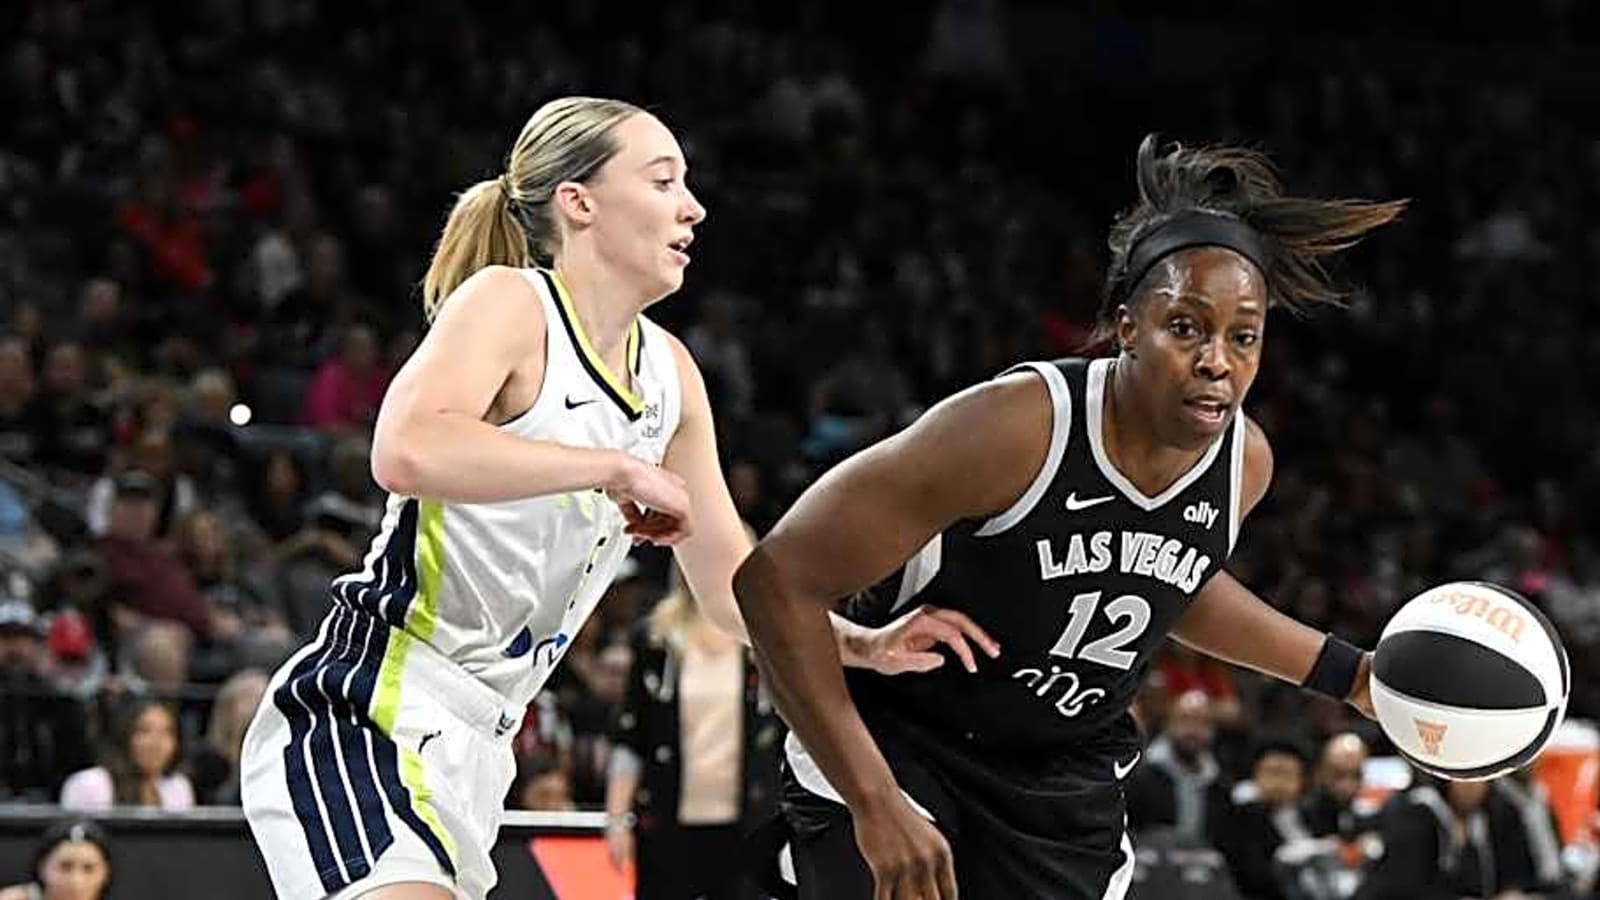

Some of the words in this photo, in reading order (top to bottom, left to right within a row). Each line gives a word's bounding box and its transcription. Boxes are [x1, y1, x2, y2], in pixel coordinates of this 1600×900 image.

[1183, 501, 1219, 530] ally
[1036, 531, 1113, 580] LAS
[1119, 530, 1211, 594] VEGAS
[1049, 590, 1151, 671] 12
